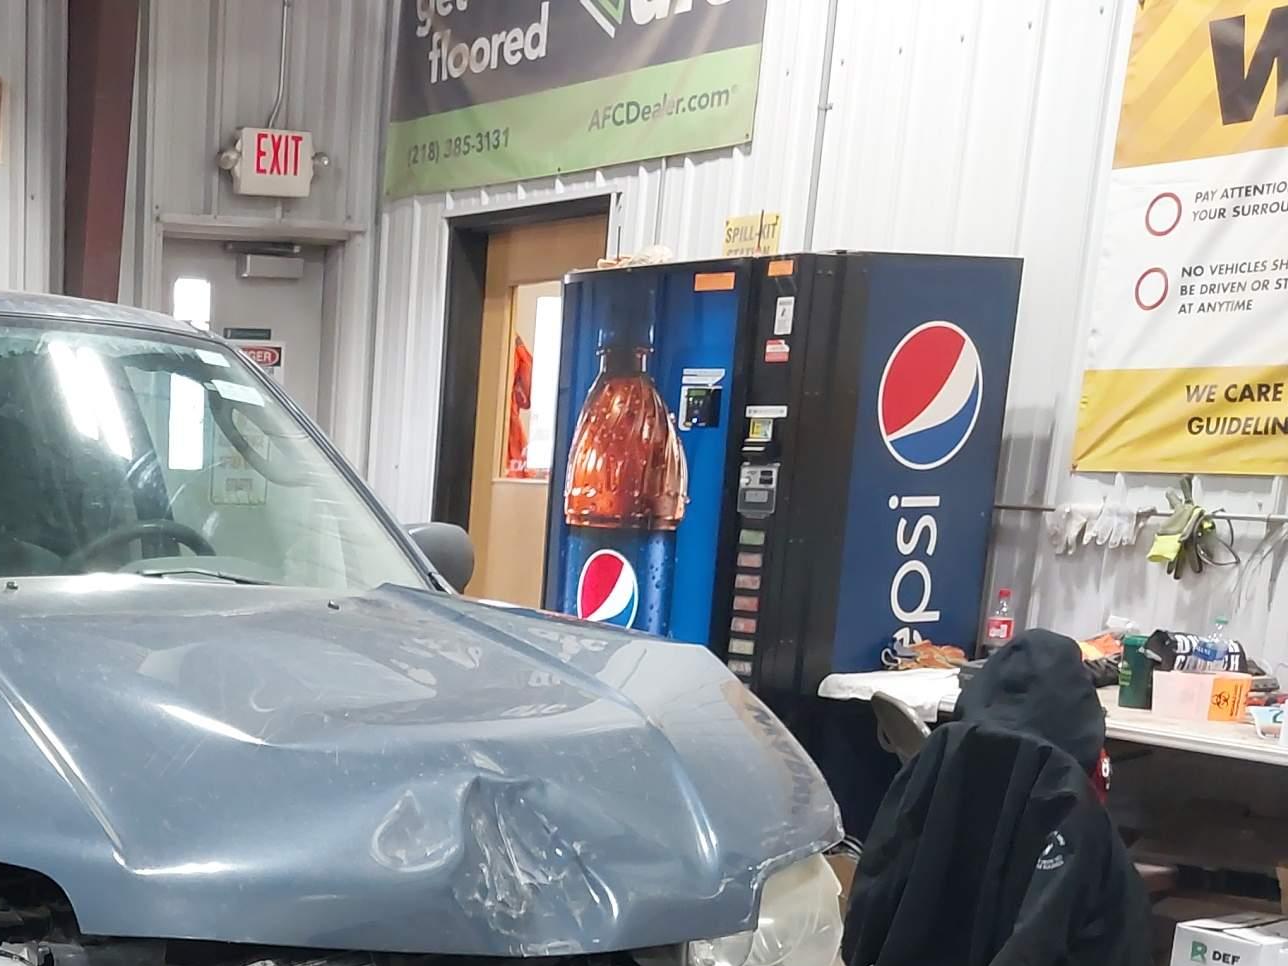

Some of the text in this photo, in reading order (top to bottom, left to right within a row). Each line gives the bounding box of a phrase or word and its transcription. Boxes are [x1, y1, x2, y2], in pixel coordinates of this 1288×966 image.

[429, 1, 550, 83] floored
[256, 133, 303, 177] EXIT
[1194, 189, 1217, 203] PAY
[1192, 207, 1226, 221] YOUR
[1181, 265, 1205, 278] NO
[1209, 260, 1268, 275] VEHICLES
[1180, 284, 1196, 296] BE
[1199, 280, 1247, 295] DRIVEN
[1250, 279, 1270, 291] OR
[1178, 299, 1253, 314] AT ANYTIME
[1185, 383, 1284, 403] WE CARE
[1212, 950, 1241, 966] DEF
